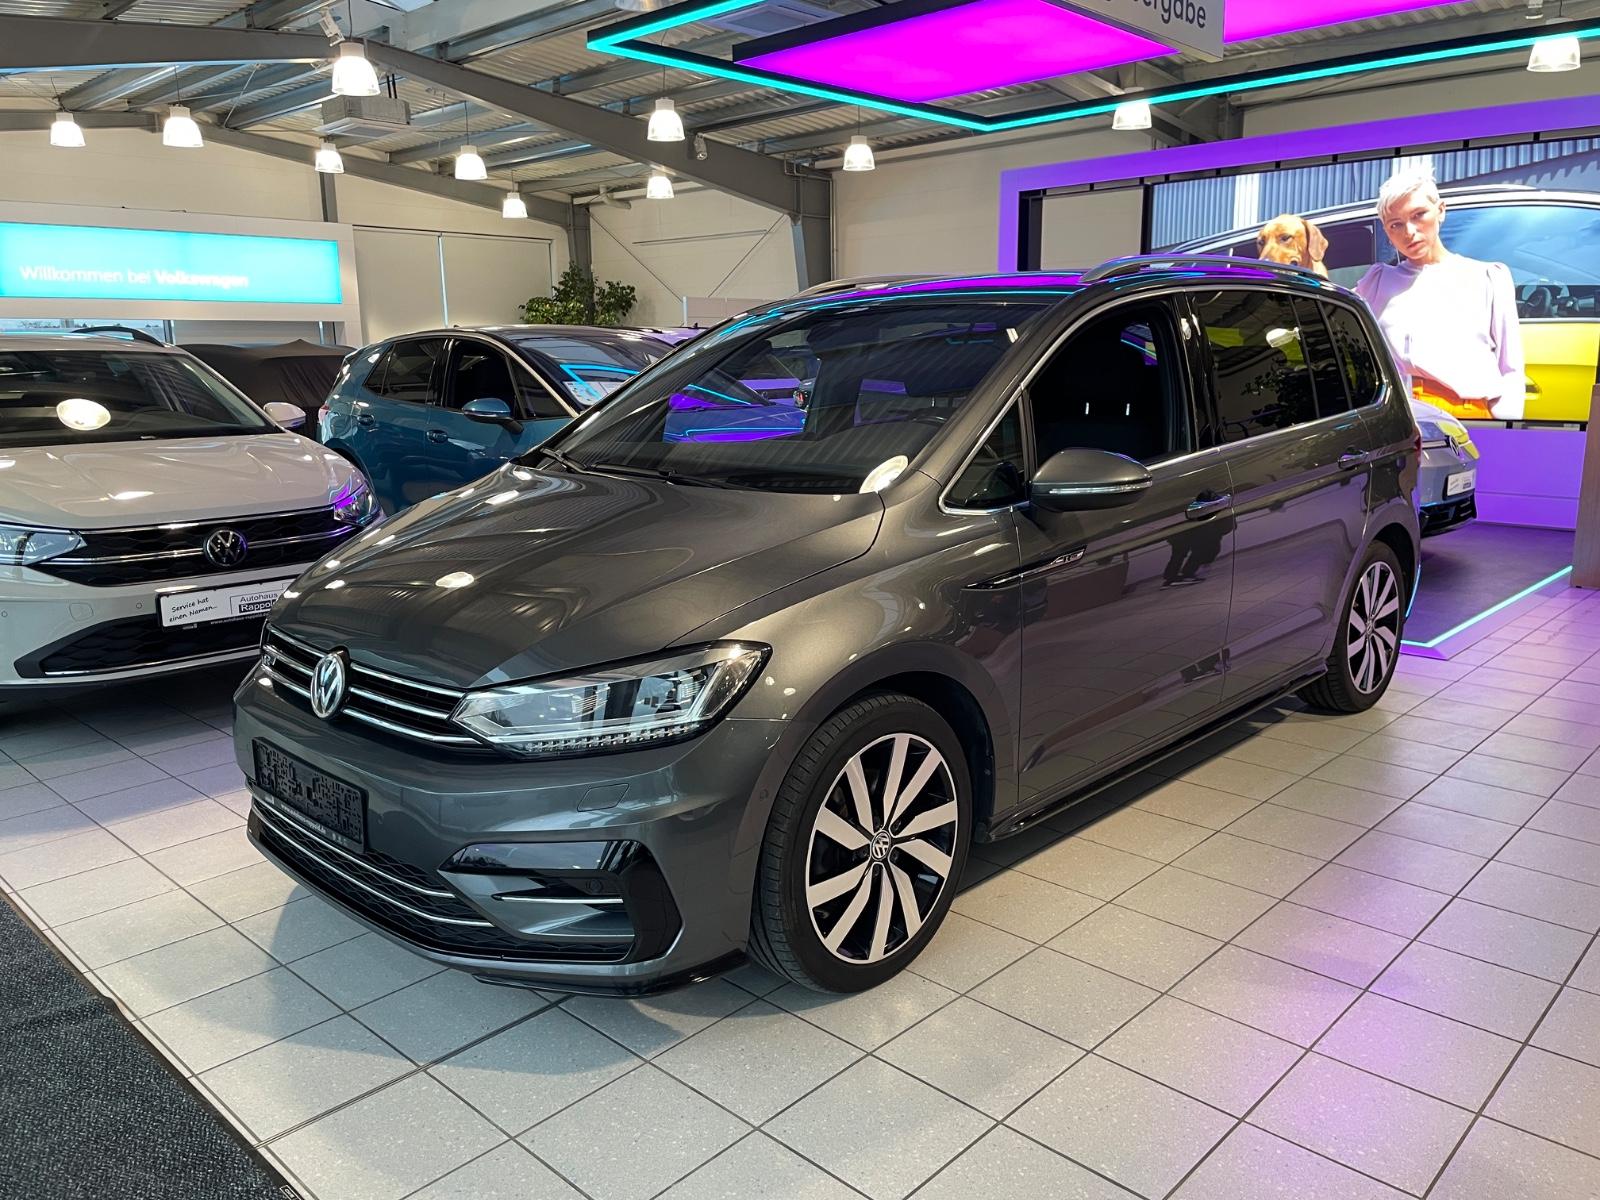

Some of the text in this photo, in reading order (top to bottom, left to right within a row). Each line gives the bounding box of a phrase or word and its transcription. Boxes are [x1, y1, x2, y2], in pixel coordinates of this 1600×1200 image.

[20, 265, 123, 284] Willkommen
[128, 268, 151, 284] bei
[171, 597, 209, 613] Service hat
[240, 593, 278, 603] Autohaus
[240, 598, 276, 613] Rappol
[169, 614, 188, 623] einen
